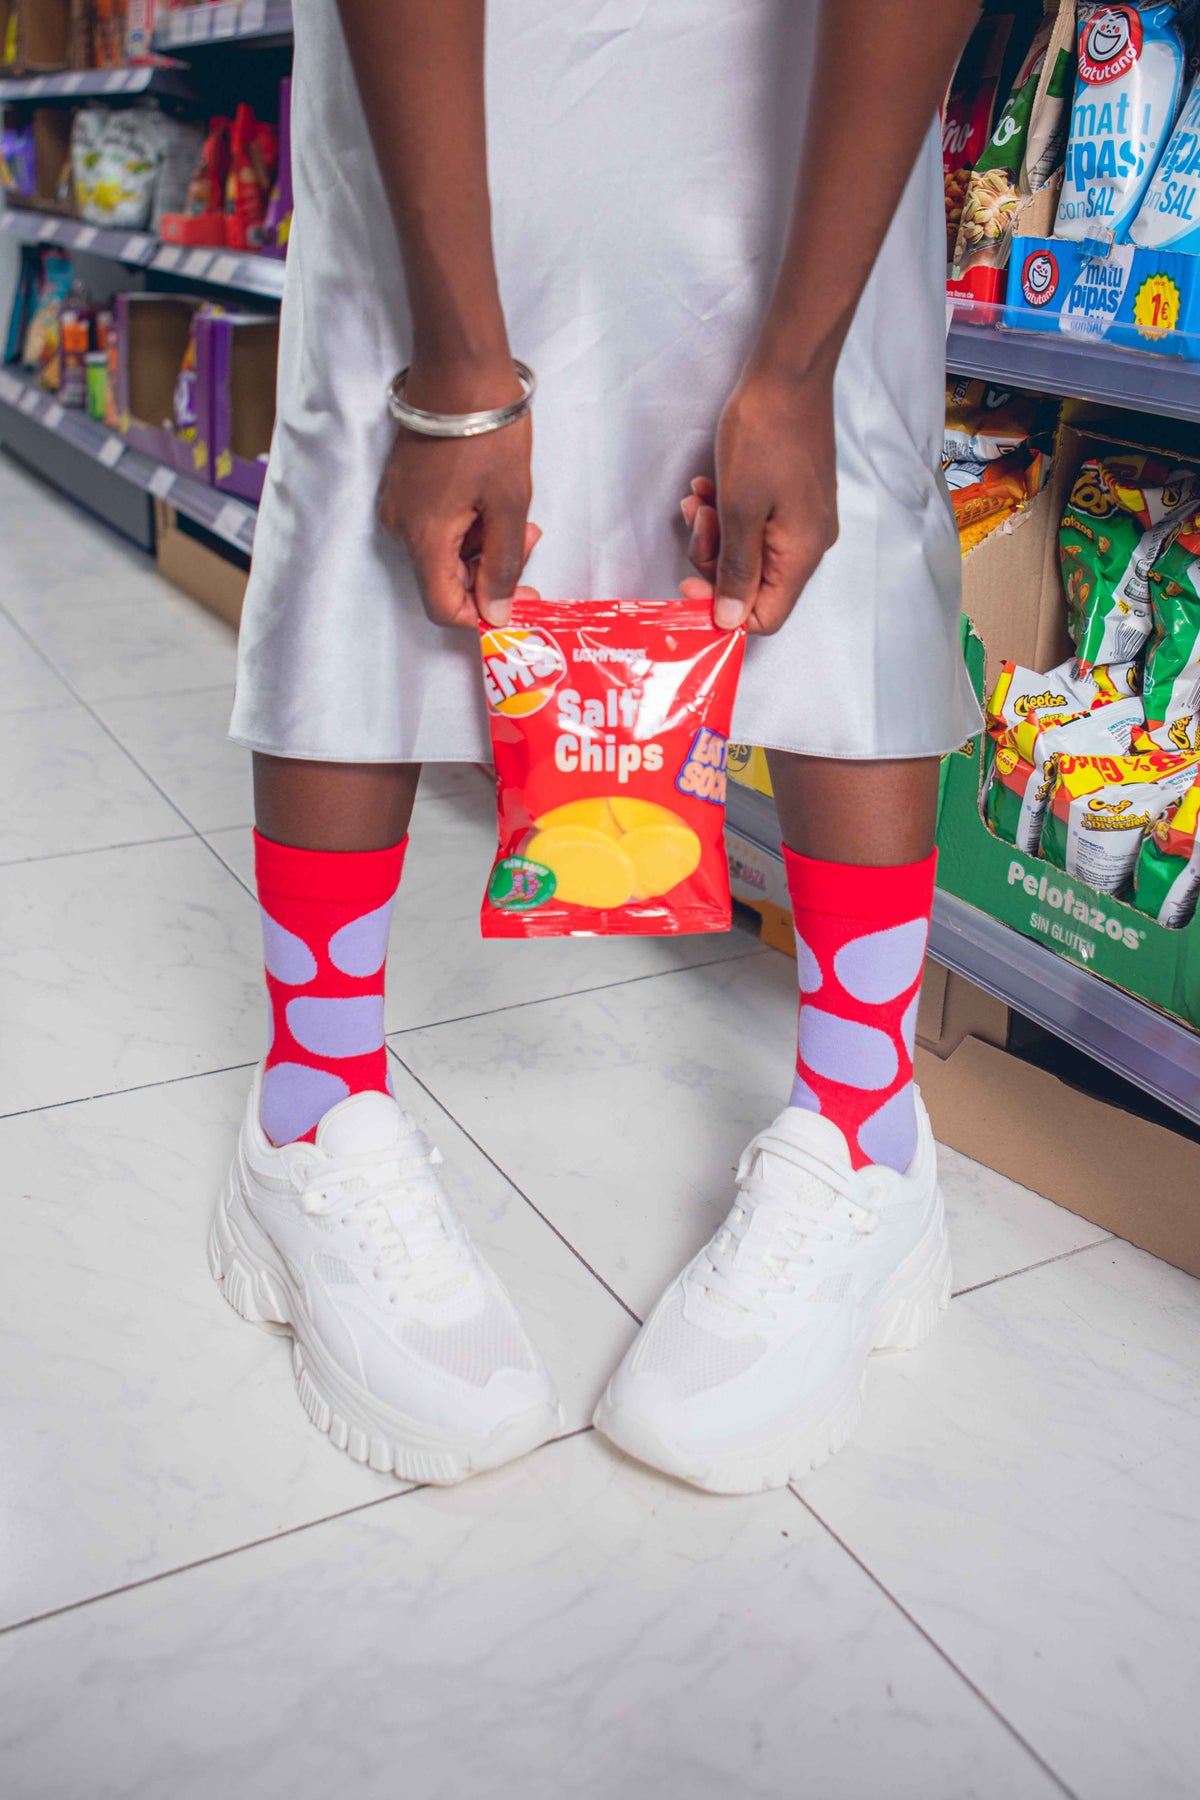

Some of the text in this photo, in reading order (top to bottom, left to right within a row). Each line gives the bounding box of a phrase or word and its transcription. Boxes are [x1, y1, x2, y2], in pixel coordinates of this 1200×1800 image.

[1014, 690, 1068, 717] Cheetos
[555, 733, 664, 783] Chips
[1007, 861, 1140, 950] Pelotazos
[1030, 912, 1050, 934] SIN
